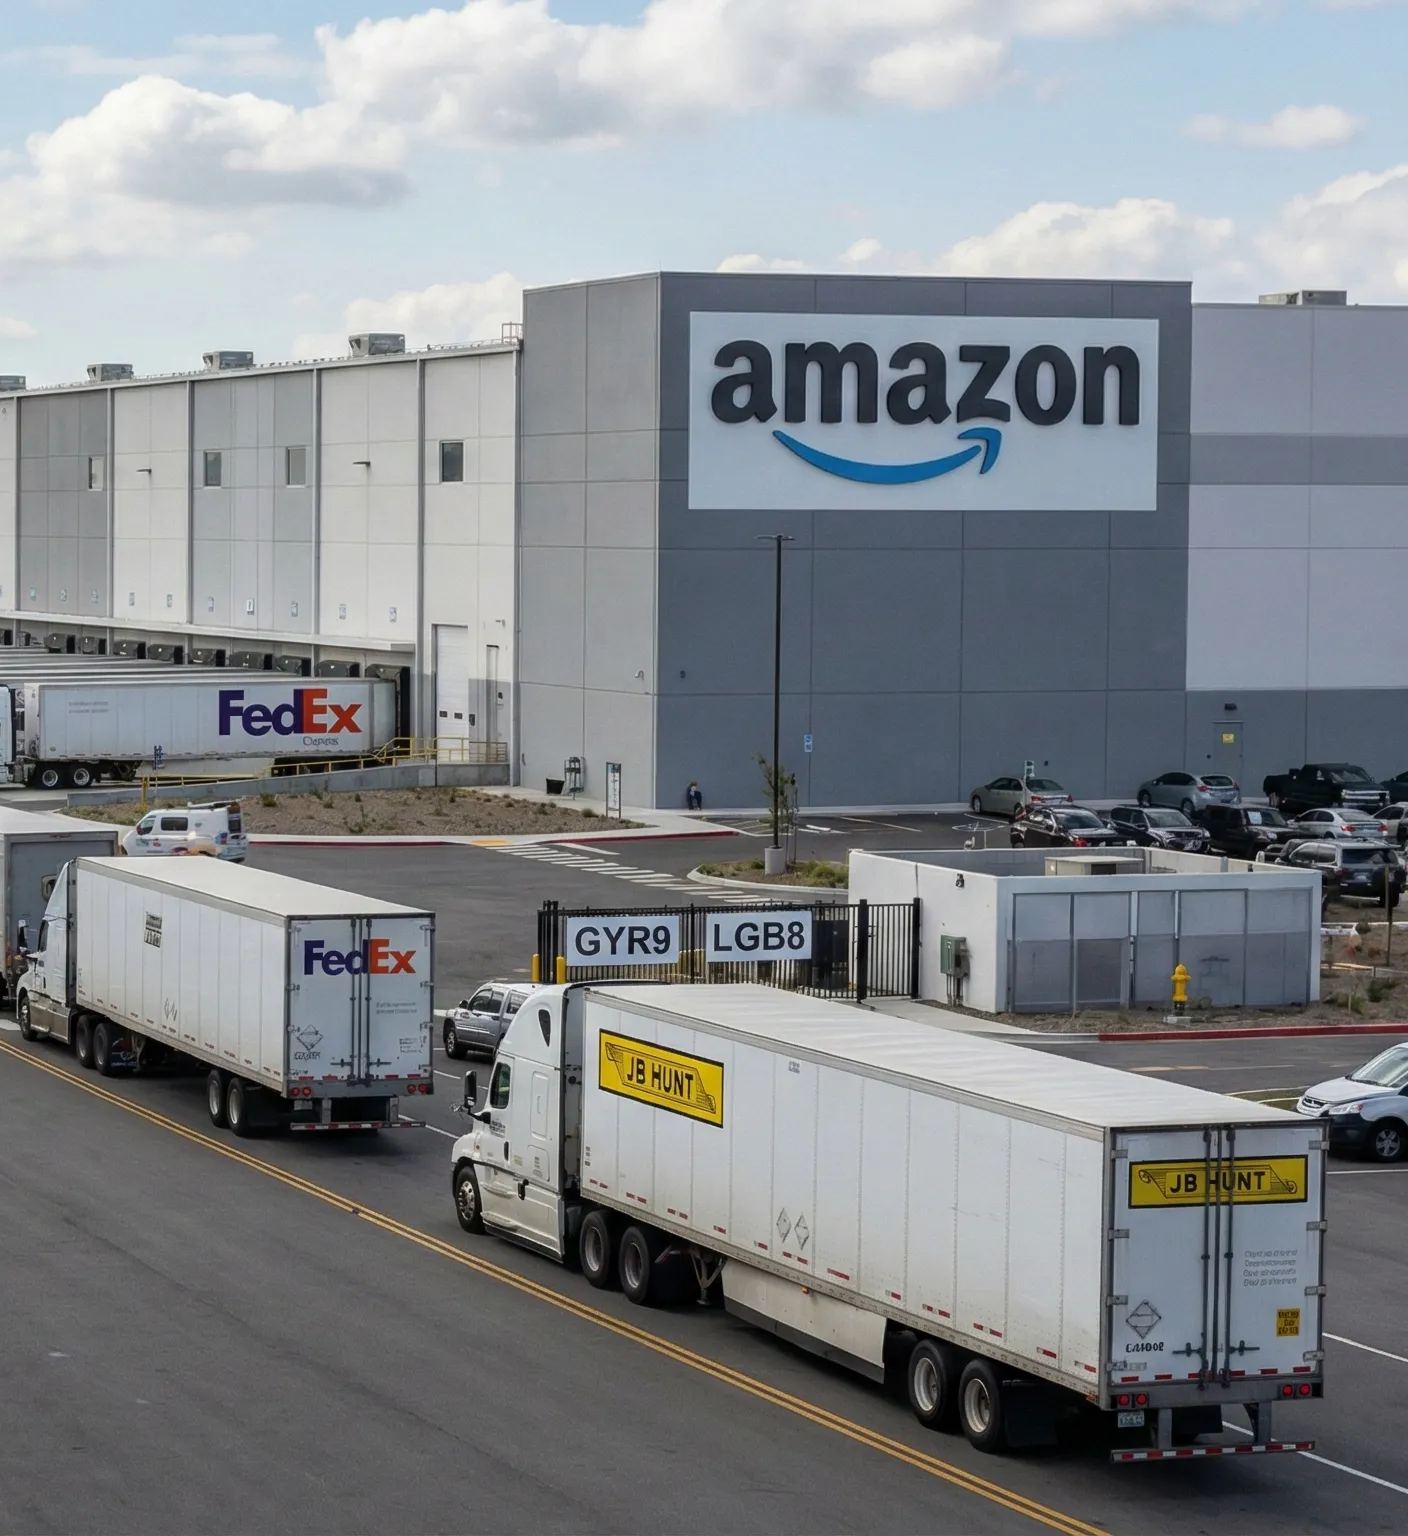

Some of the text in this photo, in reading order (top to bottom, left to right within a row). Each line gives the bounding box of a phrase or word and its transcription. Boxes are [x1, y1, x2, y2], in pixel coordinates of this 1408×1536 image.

[711, 339, 1140, 426] amazon
[219, 688, 363, 737] FedEx
[575, 925, 671, 956] GYR9
[713, 921, 805, 952] LGB8
[304, 938, 417, 976] FedEx
[627, 1056, 694, 1100] JB HUNT
[1170, 1171, 1266, 1193] JB HUNT
